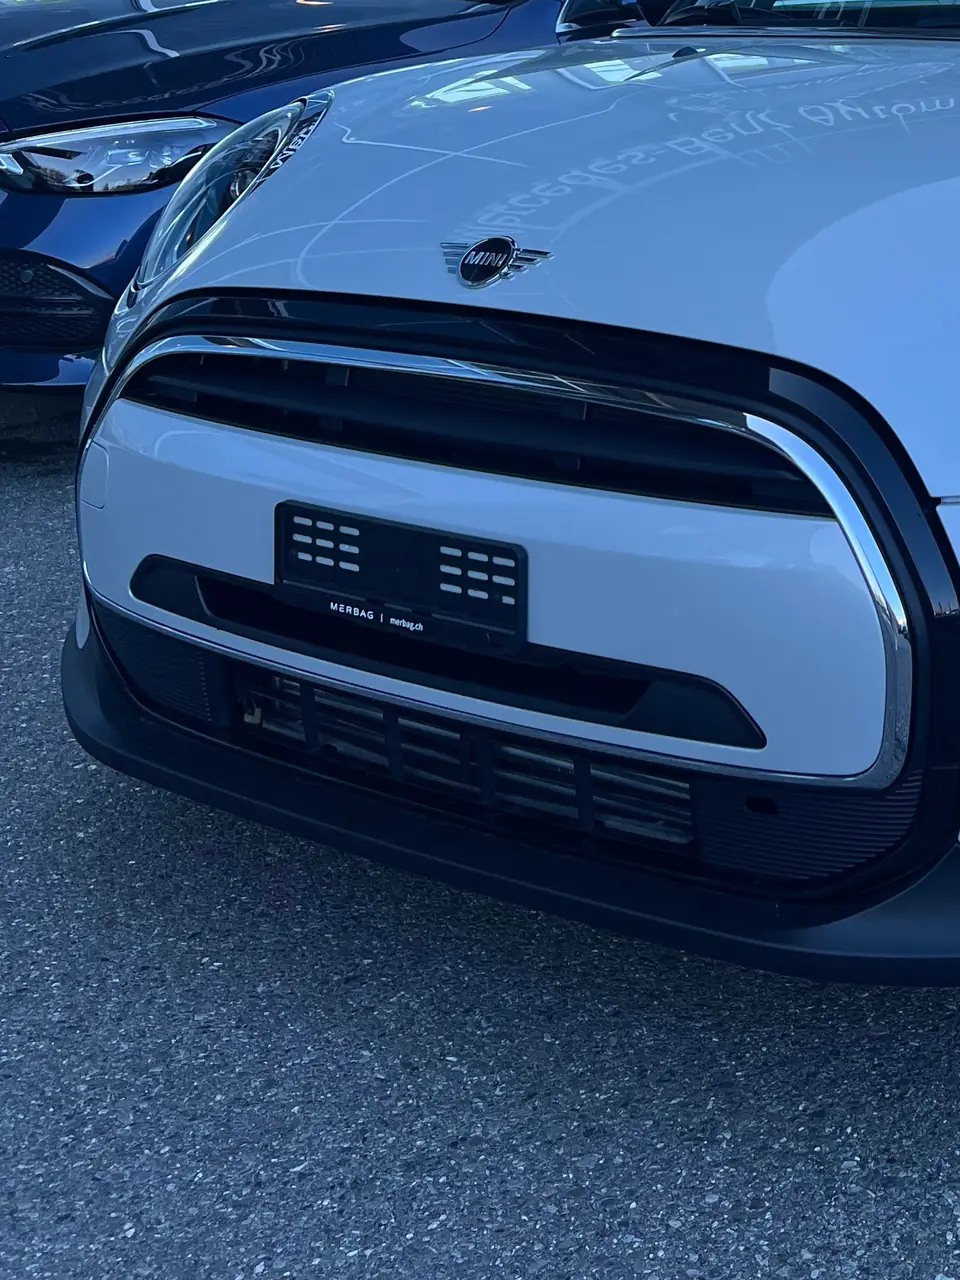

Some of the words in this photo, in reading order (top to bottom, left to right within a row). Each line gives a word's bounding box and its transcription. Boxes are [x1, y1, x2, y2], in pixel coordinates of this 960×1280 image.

[464, 251, 508, 267] MINI
[330, 602, 374, 620] MERBAG
[390, 617, 424, 631] merbag.ch
